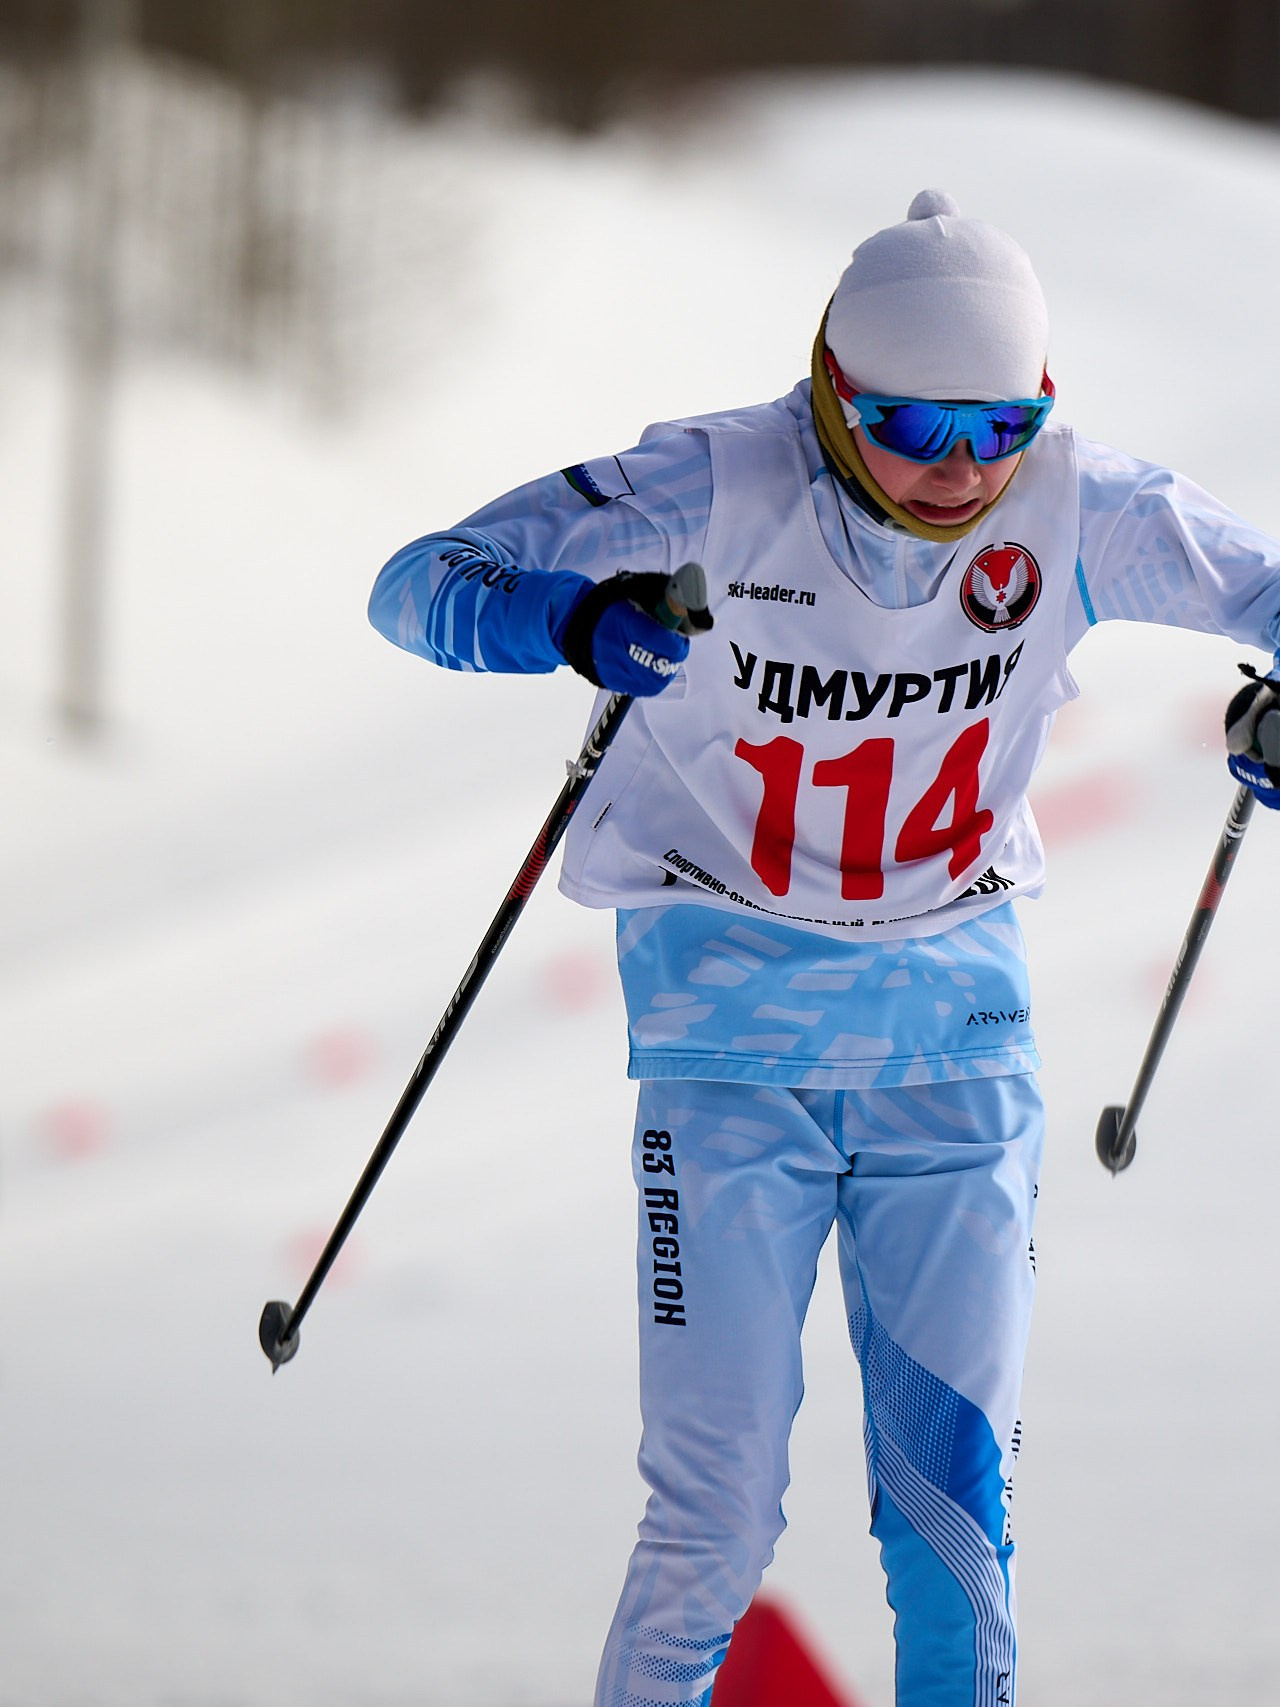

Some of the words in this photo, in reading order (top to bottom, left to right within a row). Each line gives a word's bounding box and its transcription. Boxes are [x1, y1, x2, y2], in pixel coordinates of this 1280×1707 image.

[727, 581, 816, 607] ski-leader.ru
[729, 638, 1026, 724] УДМУРТИЯ
[734, 717, 994, 901] 114
[641, 1128, 676, 1178] 83
[643, 1186, 687, 1327] REGION
